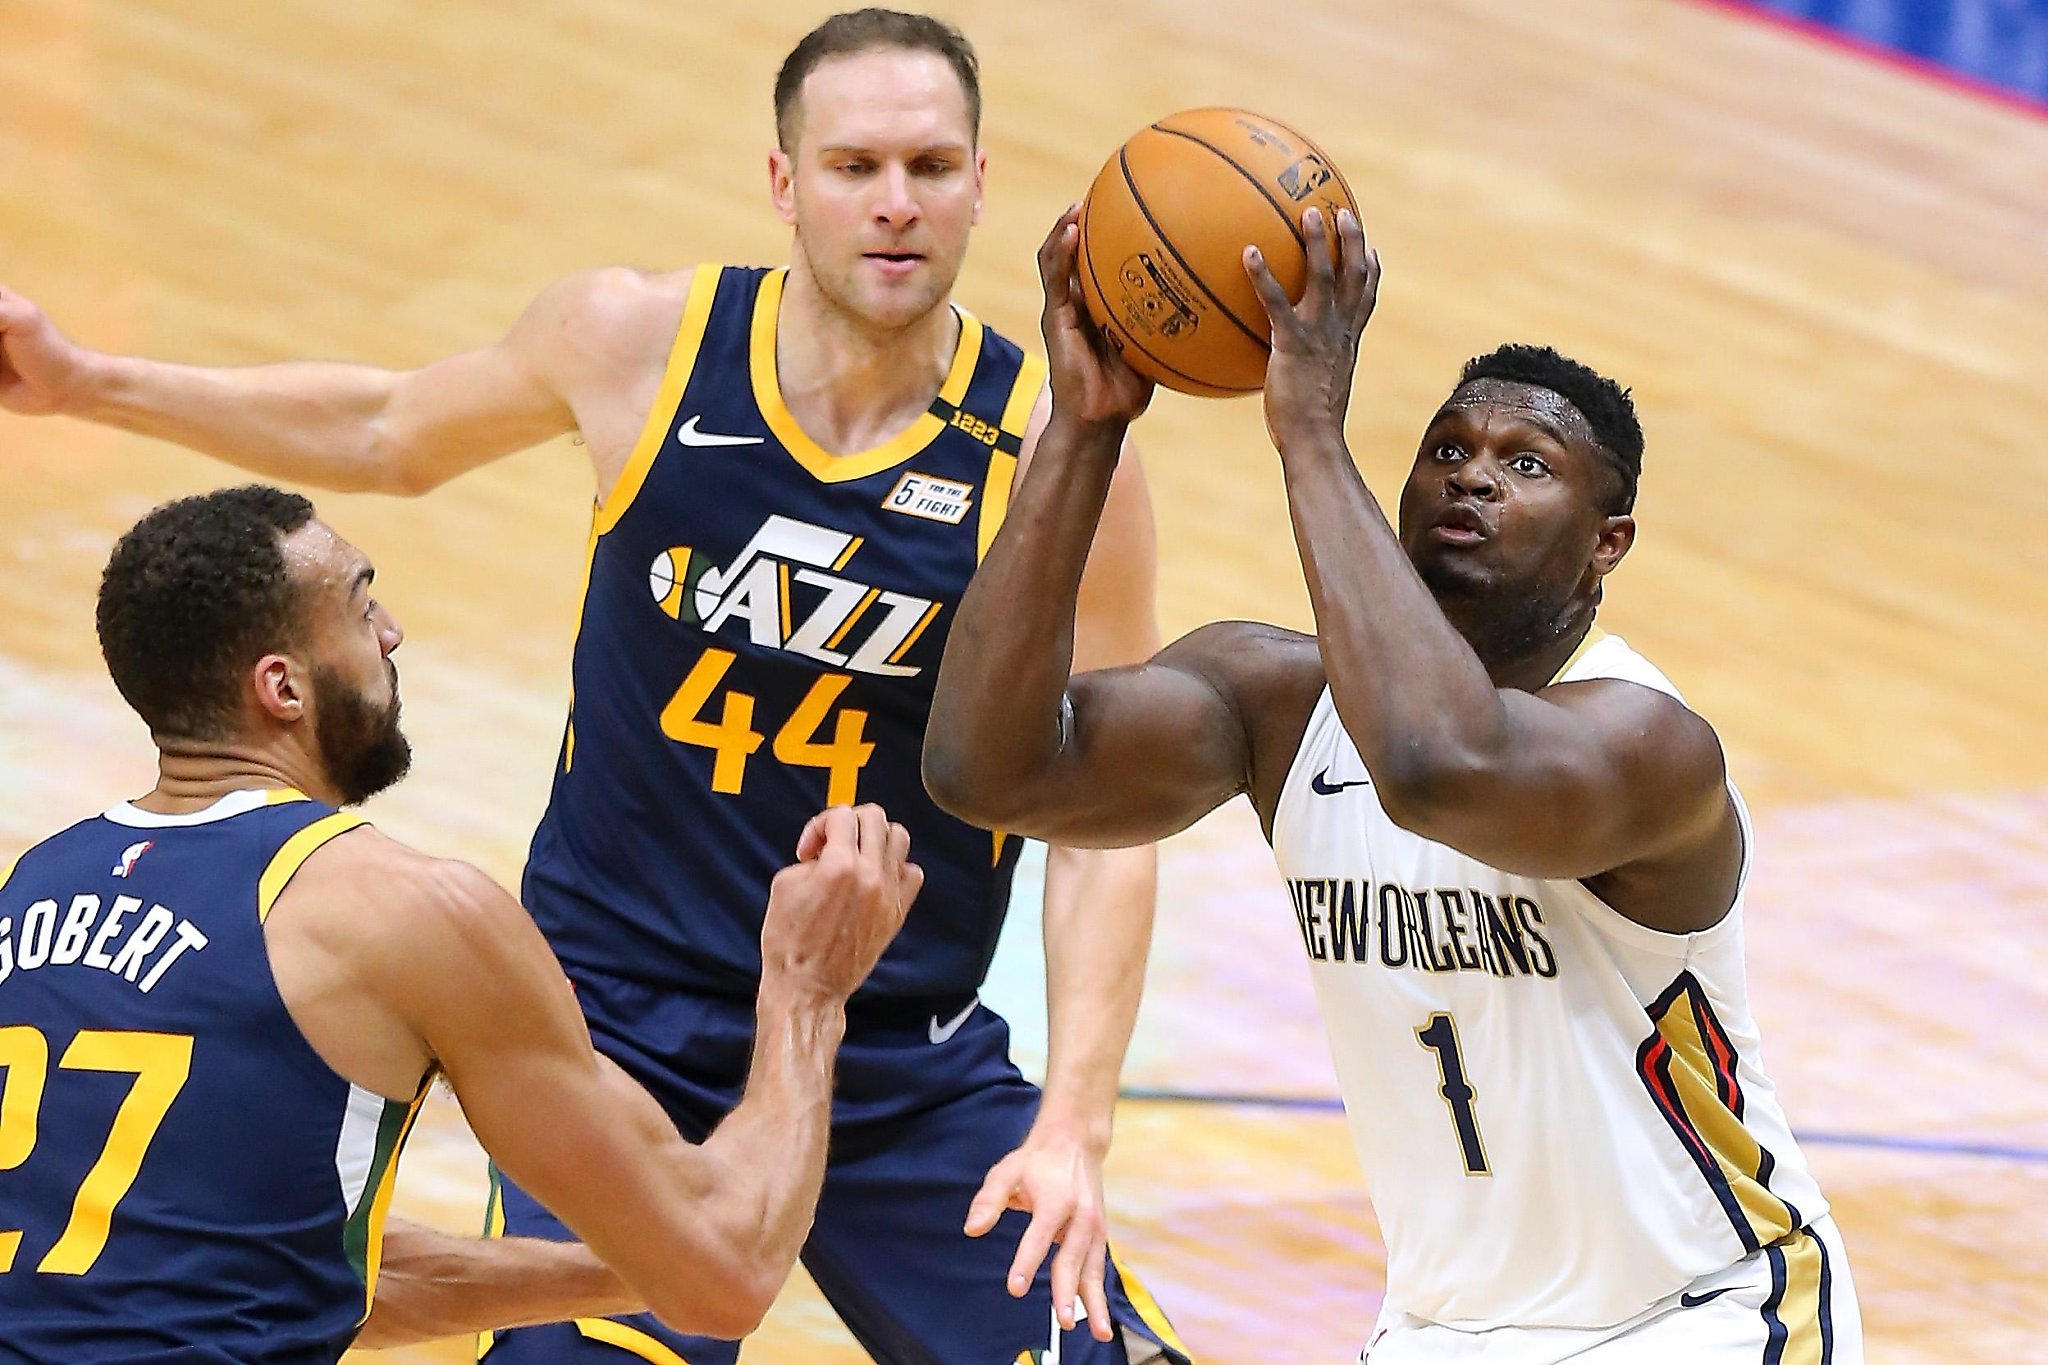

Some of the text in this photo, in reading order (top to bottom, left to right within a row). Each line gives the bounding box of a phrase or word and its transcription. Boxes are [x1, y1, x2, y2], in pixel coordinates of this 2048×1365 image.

[950, 409, 1000, 446] 1223
[894, 479, 921, 506] 5
[916, 497, 962, 516] FIGHT
[650, 513, 943, 677] JAZZ
[659, 647, 876, 808] 44
[1377, 882, 1560, 978] ORLEANS
[1412, 1011, 1493, 1177] 1
